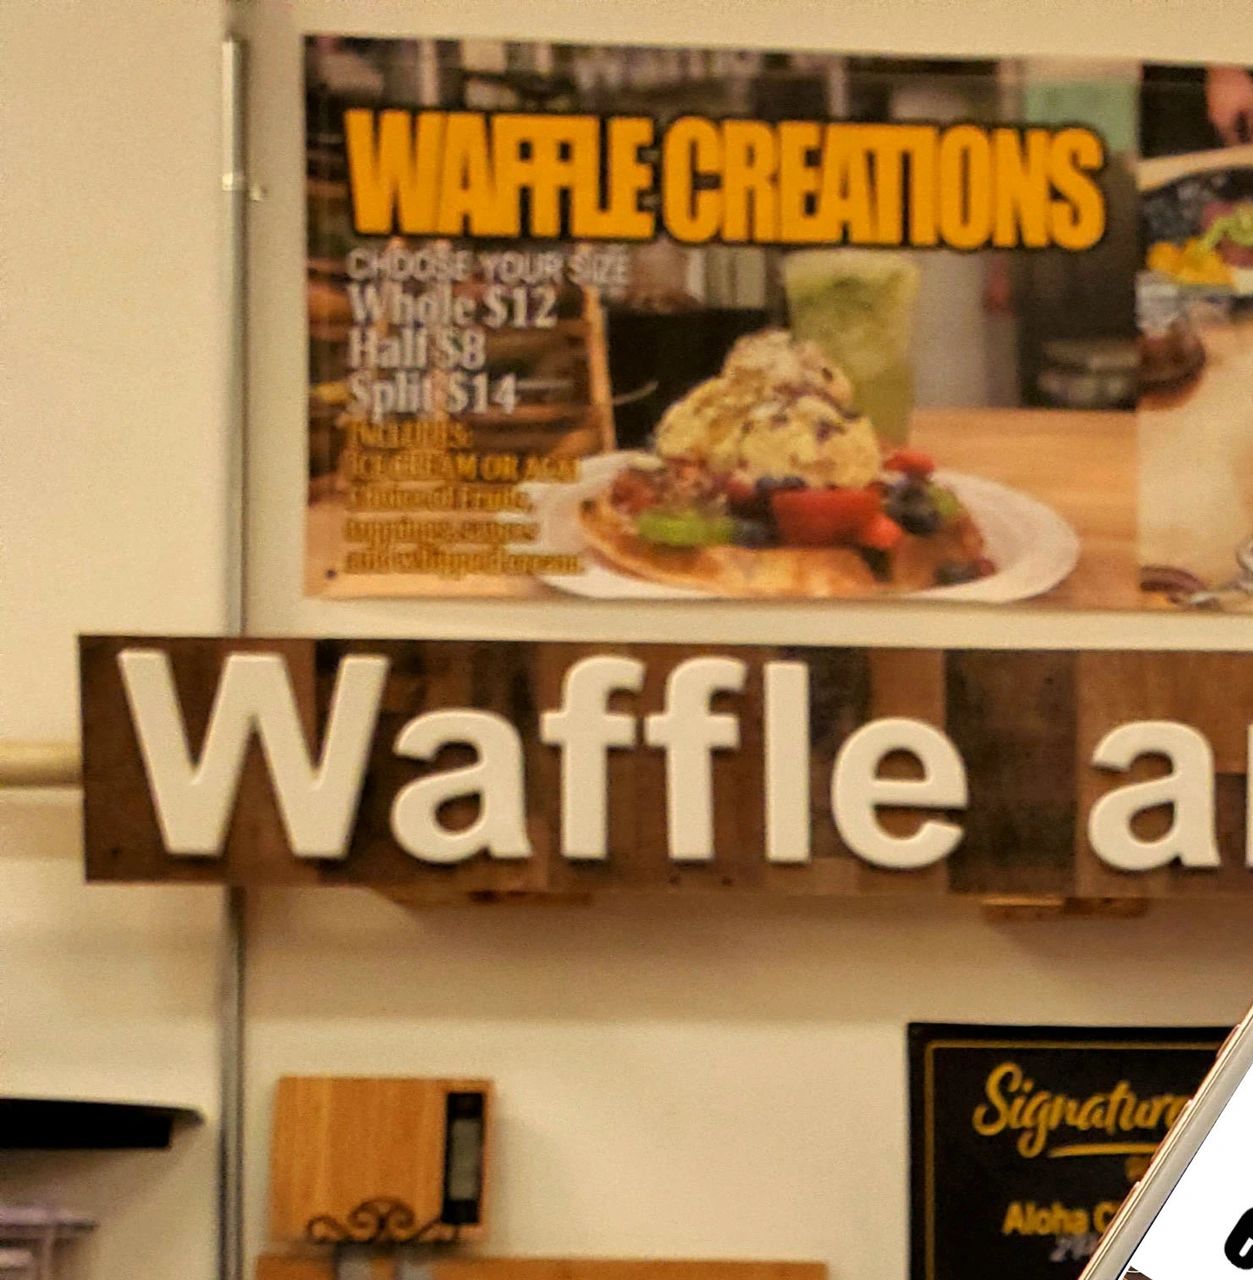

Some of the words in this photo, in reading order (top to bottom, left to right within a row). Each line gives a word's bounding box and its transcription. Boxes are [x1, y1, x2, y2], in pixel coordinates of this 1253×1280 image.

[345, 107, 657, 240] WAFFLE
[661, 115, 1110, 250] CREATIONS
[347, 247, 473, 281] CHOOSE
[479, 250, 564, 286] YOUR
[348, 281, 477, 327] Whole
[483, 284, 559, 330] $12
[350, 327, 428, 369] Half
[436, 328, 486, 371] $8
[349, 370, 432, 424] Split
[448, 372, 520, 415] $14
[117, 647, 969, 872] Waffle
[1003, 1200, 1090, 1236] Aloha
